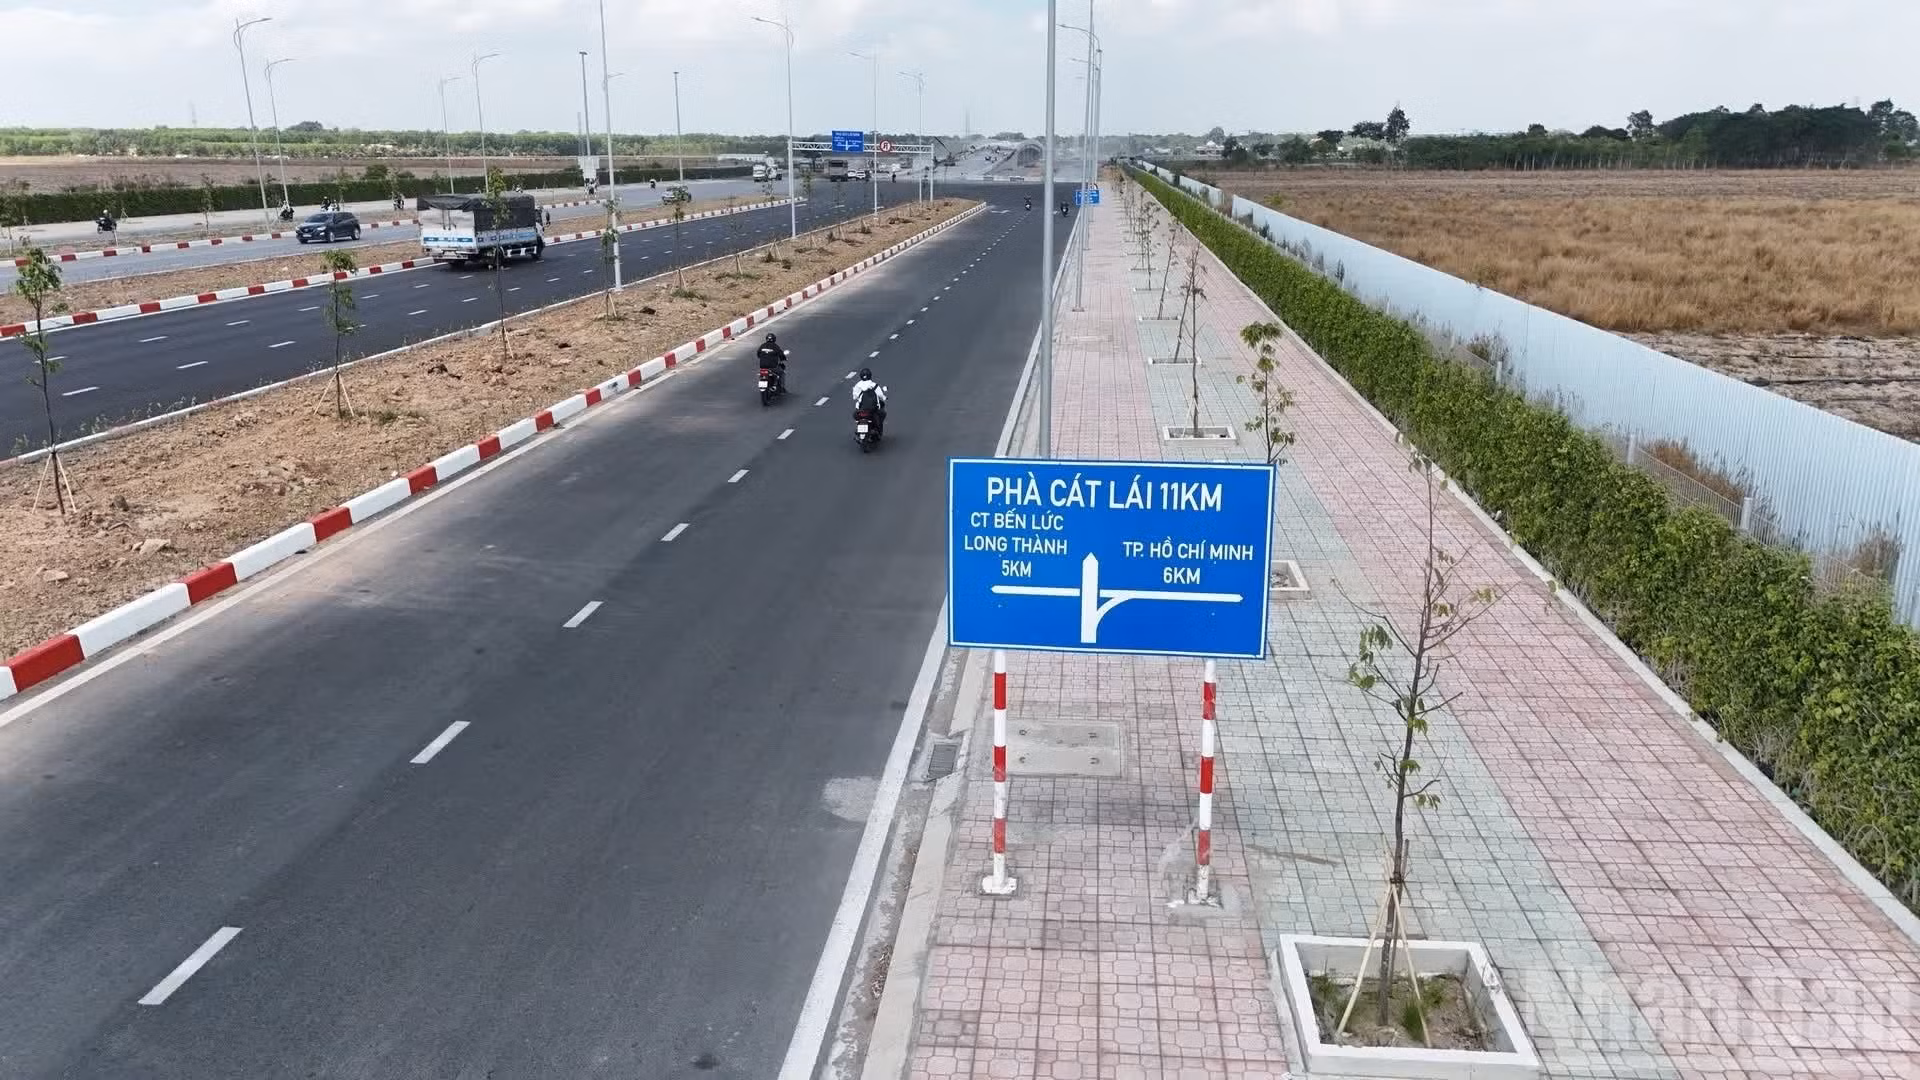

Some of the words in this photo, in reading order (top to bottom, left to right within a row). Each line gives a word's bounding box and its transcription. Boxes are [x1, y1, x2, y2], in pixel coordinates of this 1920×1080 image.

[987, 471, 1042, 506] PHÀ
[1050, 472, 1102, 508] CÁT
[1109, 474, 1153, 510] LÁI
[1160, 481, 1223, 512] 11KM
[970, 511, 990, 528] CT
[994, 507, 1027, 529] BẾN
[1031, 510, 1064, 531] LỨC
[964, 535, 1008, 552] LONG
[1011, 533, 1068, 555] THÀNH
[1122, 541, 1144, 558] TP.
[1150, 536, 1173, 559] HỒ
[1177, 539, 1206, 560] CHÍ
[1209, 543, 1254, 561] MINH
[1001, 559, 1032, 578] 5KM
[1163, 566, 1201, 584] 6KM
